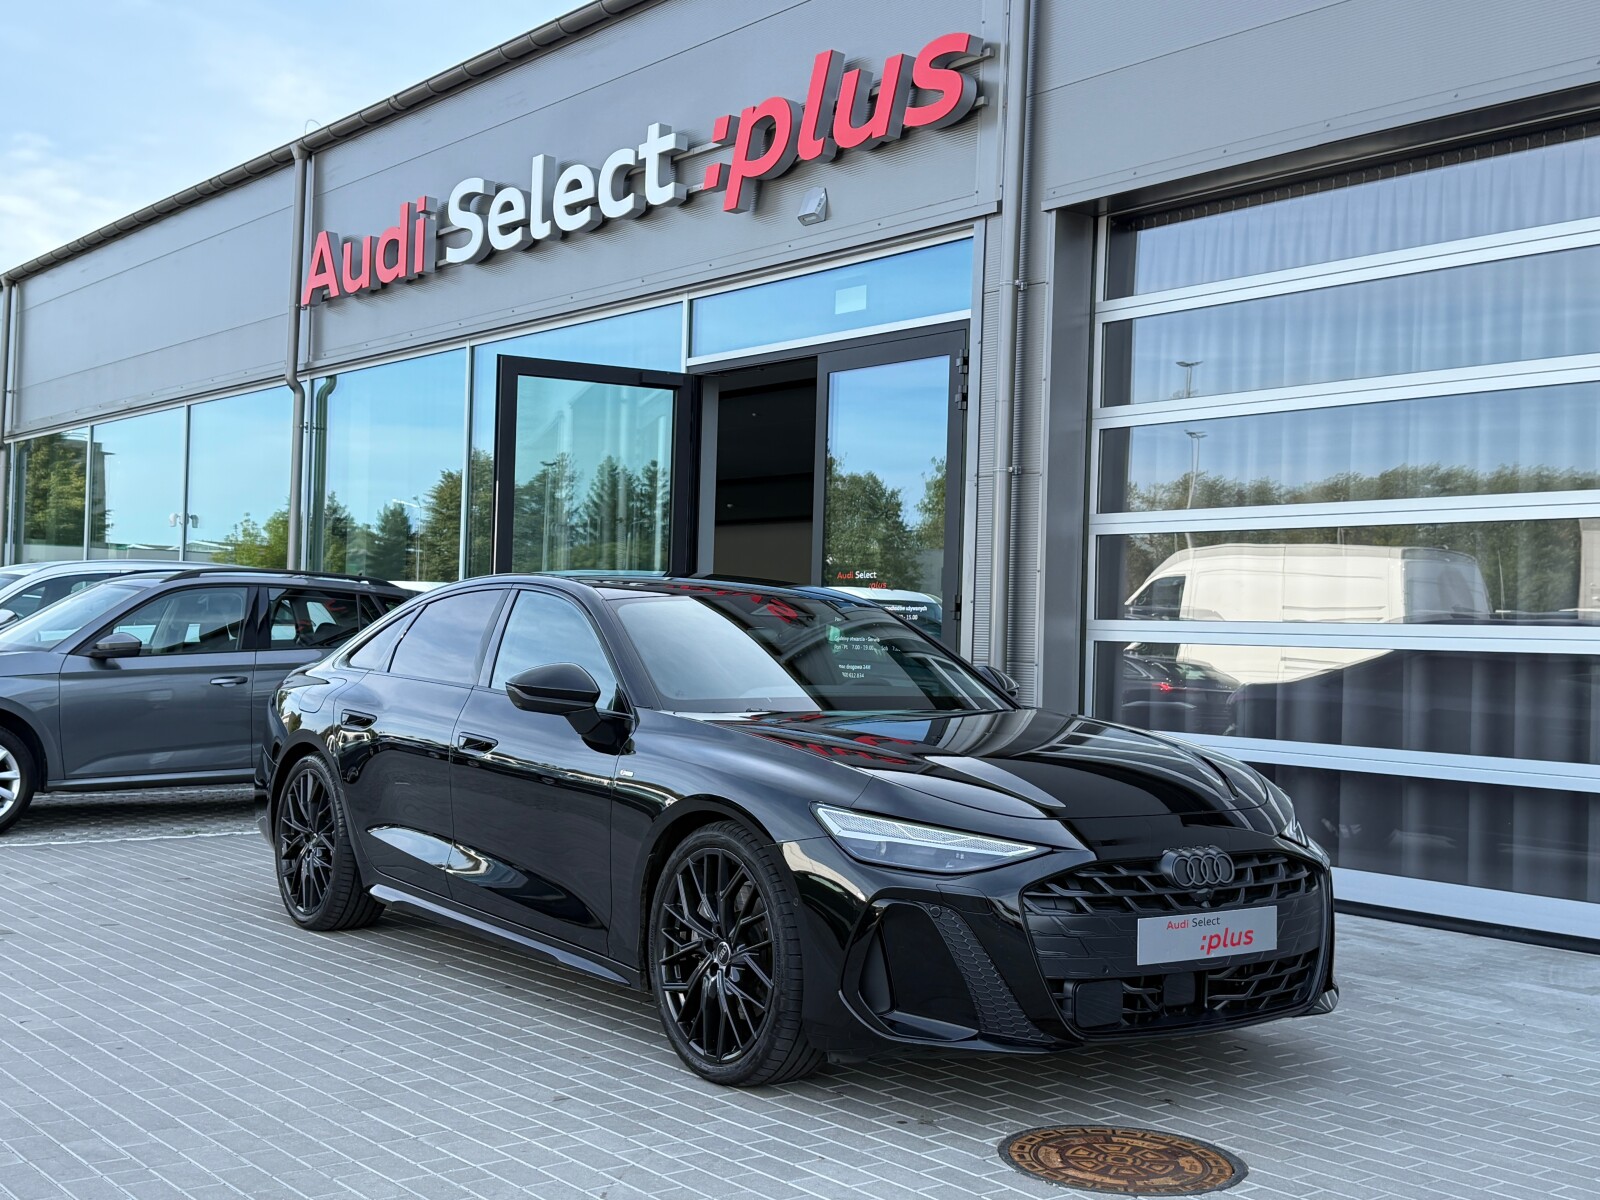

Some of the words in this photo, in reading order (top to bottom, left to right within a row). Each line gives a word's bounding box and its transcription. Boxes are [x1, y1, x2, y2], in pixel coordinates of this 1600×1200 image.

[301, 196, 431, 308] Audi
[445, 122, 678, 265] Select
[837, 571, 853, 579] Audi
[855, 571, 877, 579] Select
[1166, 920, 1189, 930] Audi
[1192, 917, 1221, 928] Select
